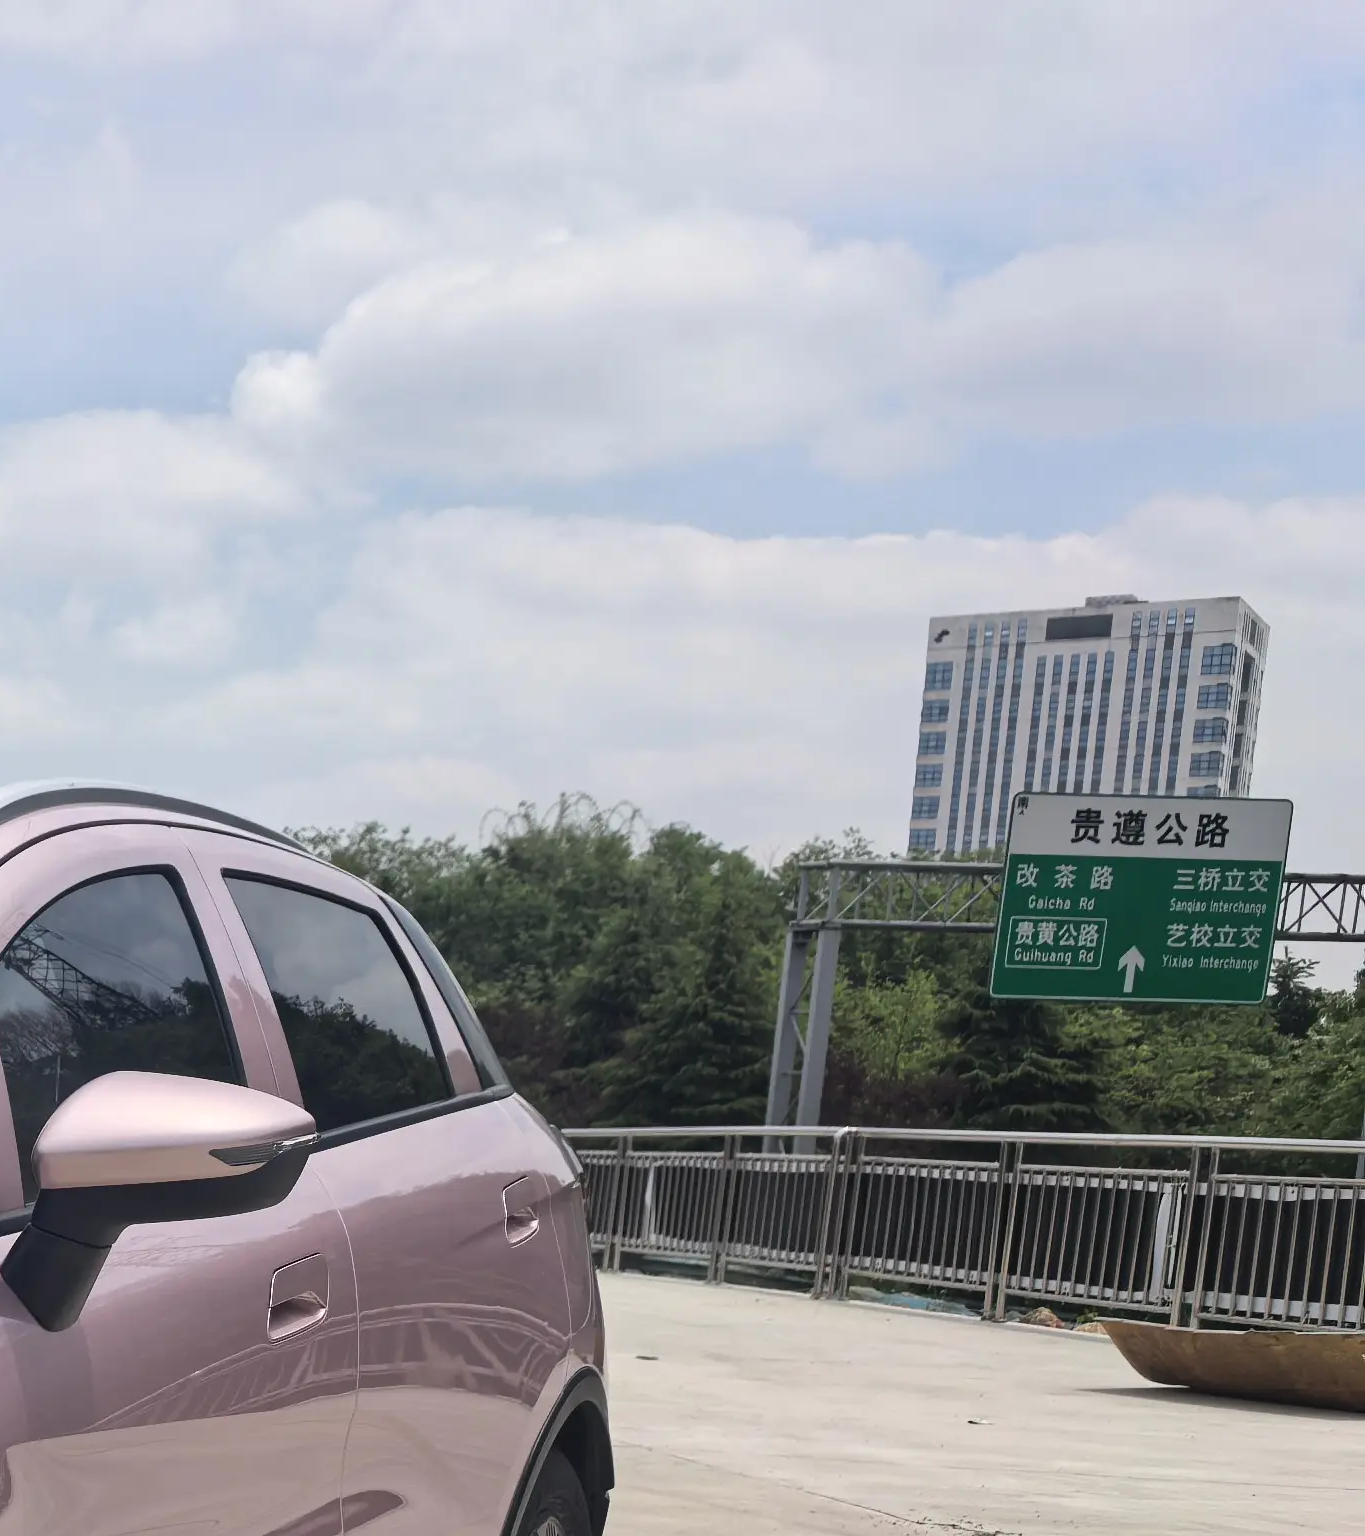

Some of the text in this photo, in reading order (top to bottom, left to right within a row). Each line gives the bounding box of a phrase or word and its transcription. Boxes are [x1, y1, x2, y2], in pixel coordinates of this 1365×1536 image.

[1070, 808, 1230, 848] 贵遵公路
[1016, 862, 1114, 889] 改茶路
[1172, 867, 1271, 892] 三桥立交
[1079, 897, 1095, 911] Rd
[1169, 897, 1267, 917] Sanqiao Interchange
[1015, 921, 1099, 948] 贵黄公路
[1166, 923, 1263, 948] 艺校立交
[1014, 948, 1095, 966] Guihuang Rd
[1200, 955, 1259, 973] Interchange
